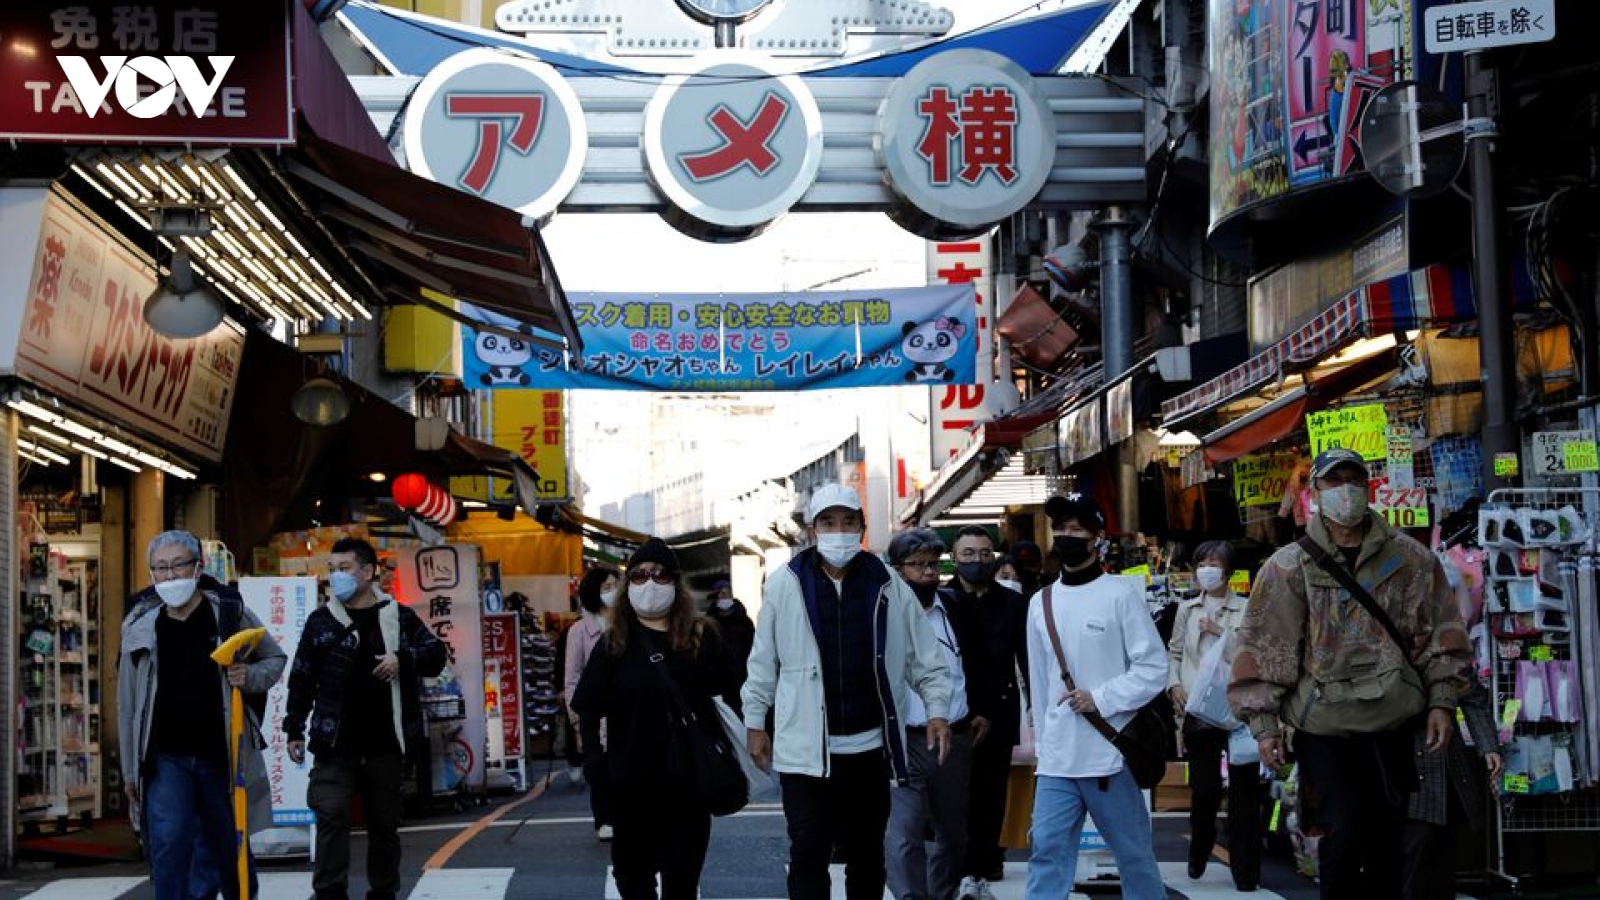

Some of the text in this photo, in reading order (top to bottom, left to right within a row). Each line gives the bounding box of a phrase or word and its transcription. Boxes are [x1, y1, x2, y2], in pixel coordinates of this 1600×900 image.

[51, 7, 218, 52] 免税店
[1435, 8, 1546, 42] 自転車を除く
[446, 87, 1018, 193] アメ横
[570, 300, 891, 328] スク着用・安心安全なお買物
[630, 332, 790, 352] 命名おめでとう
[521, 423, 539, 469] プラ
